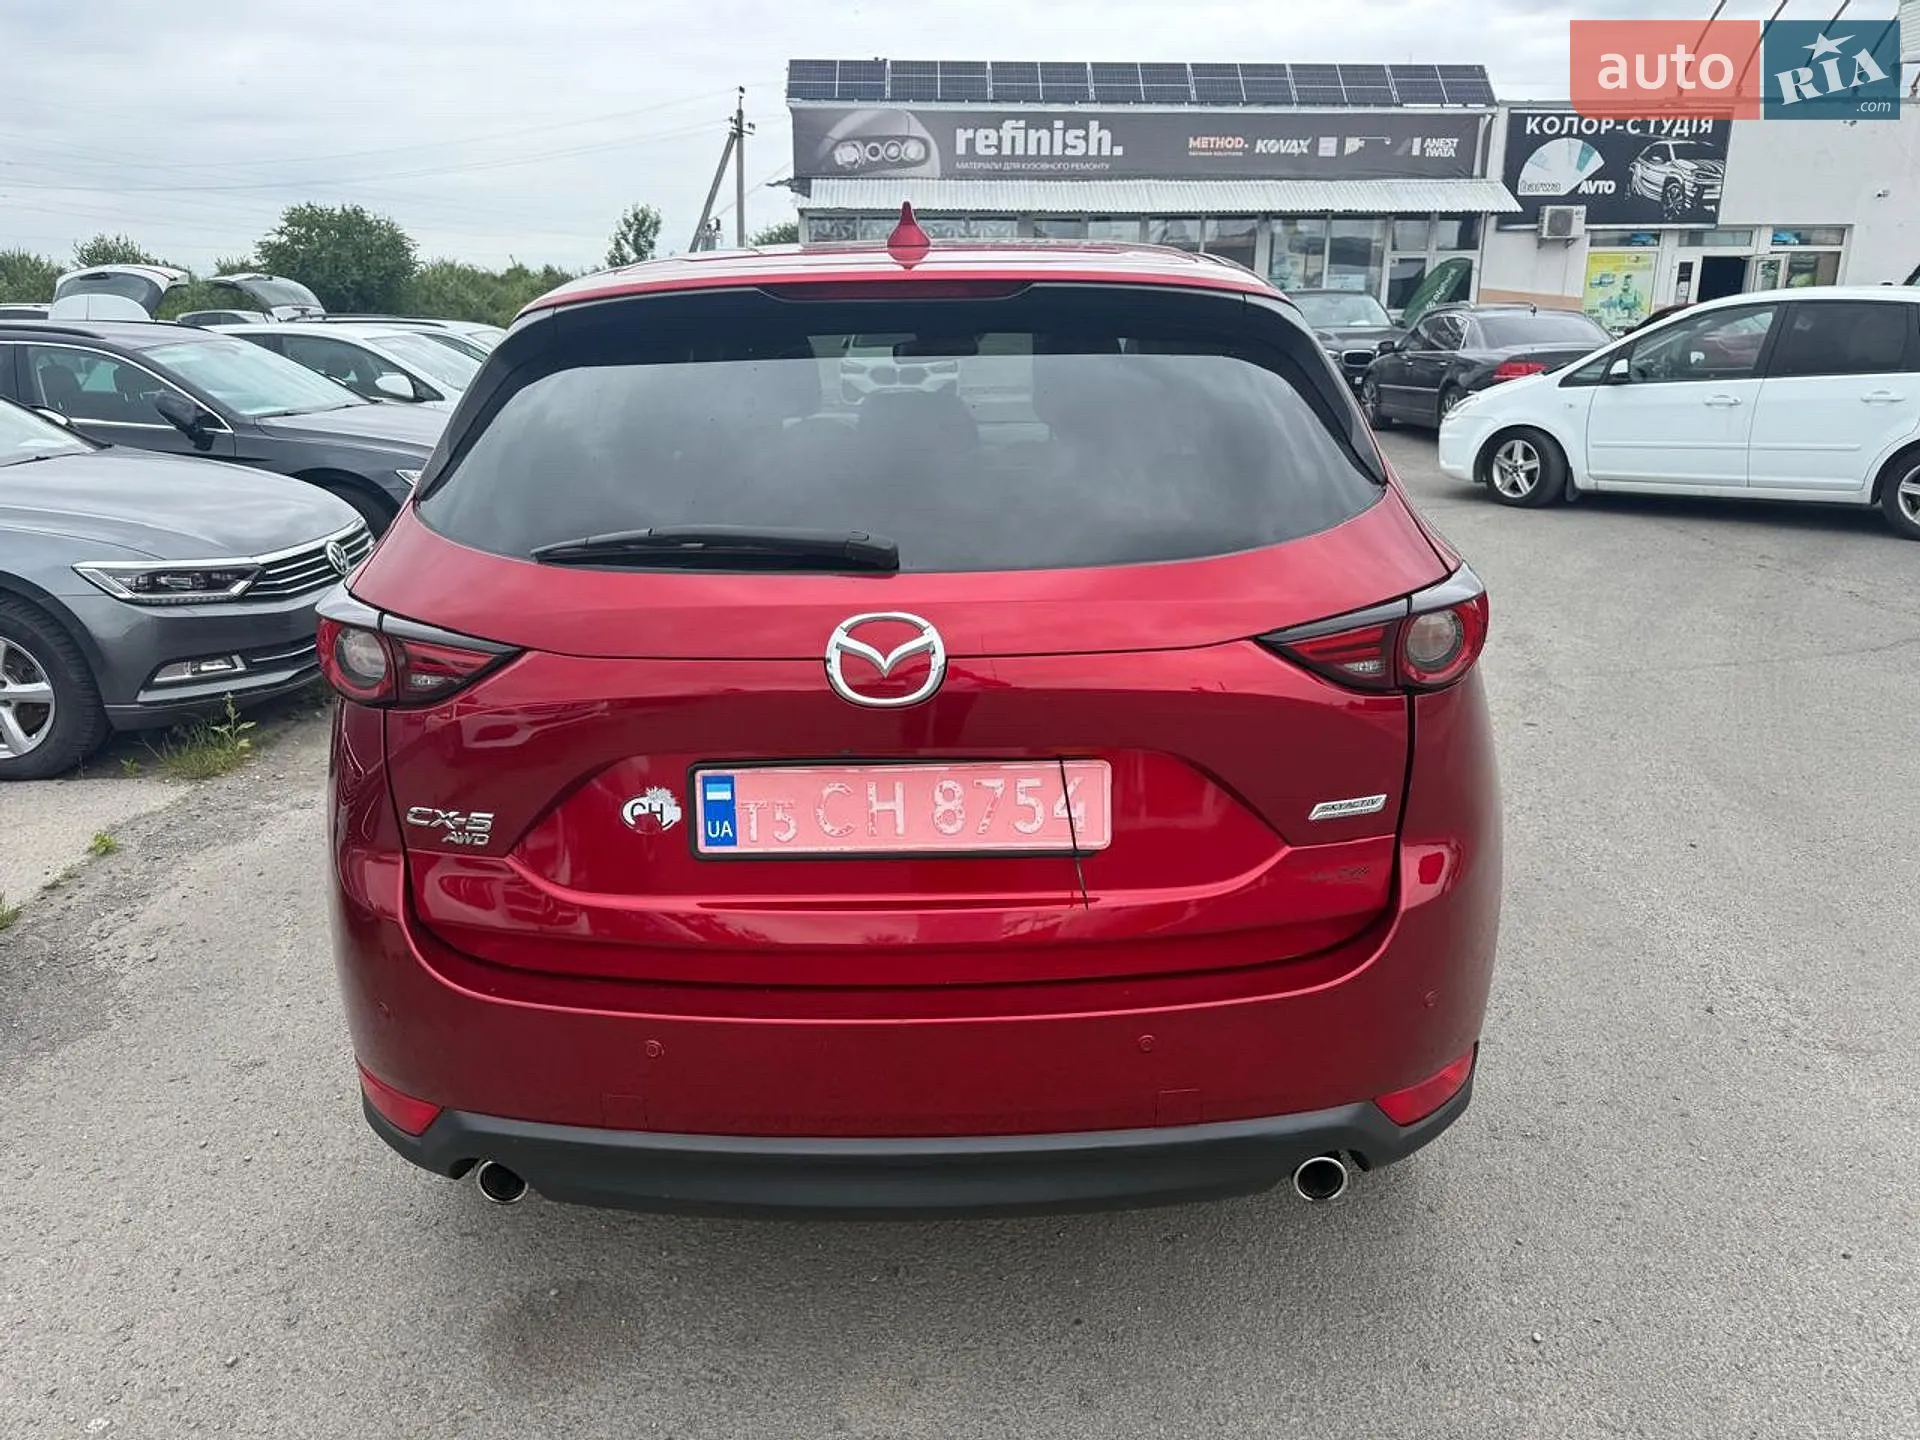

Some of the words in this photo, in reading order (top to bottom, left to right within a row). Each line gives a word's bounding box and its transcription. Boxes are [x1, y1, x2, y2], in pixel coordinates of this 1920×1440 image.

[955, 119, 1124, 156] refinish.
[1188, 136, 1249, 149] METHOD.
[1255, 136, 1313, 157] KOVAX
[1423, 137, 1459, 148] ANEST
[1577, 180, 1617, 194] AVTO
[739, 801, 798, 842] T5
[814, 780, 905, 838] CH
[931, 777, 1087, 837] 8754
[406, 806, 495, 833] CX-5
[707, 820, 734, 838] UA
[441, 832, 490, 845] AWD
